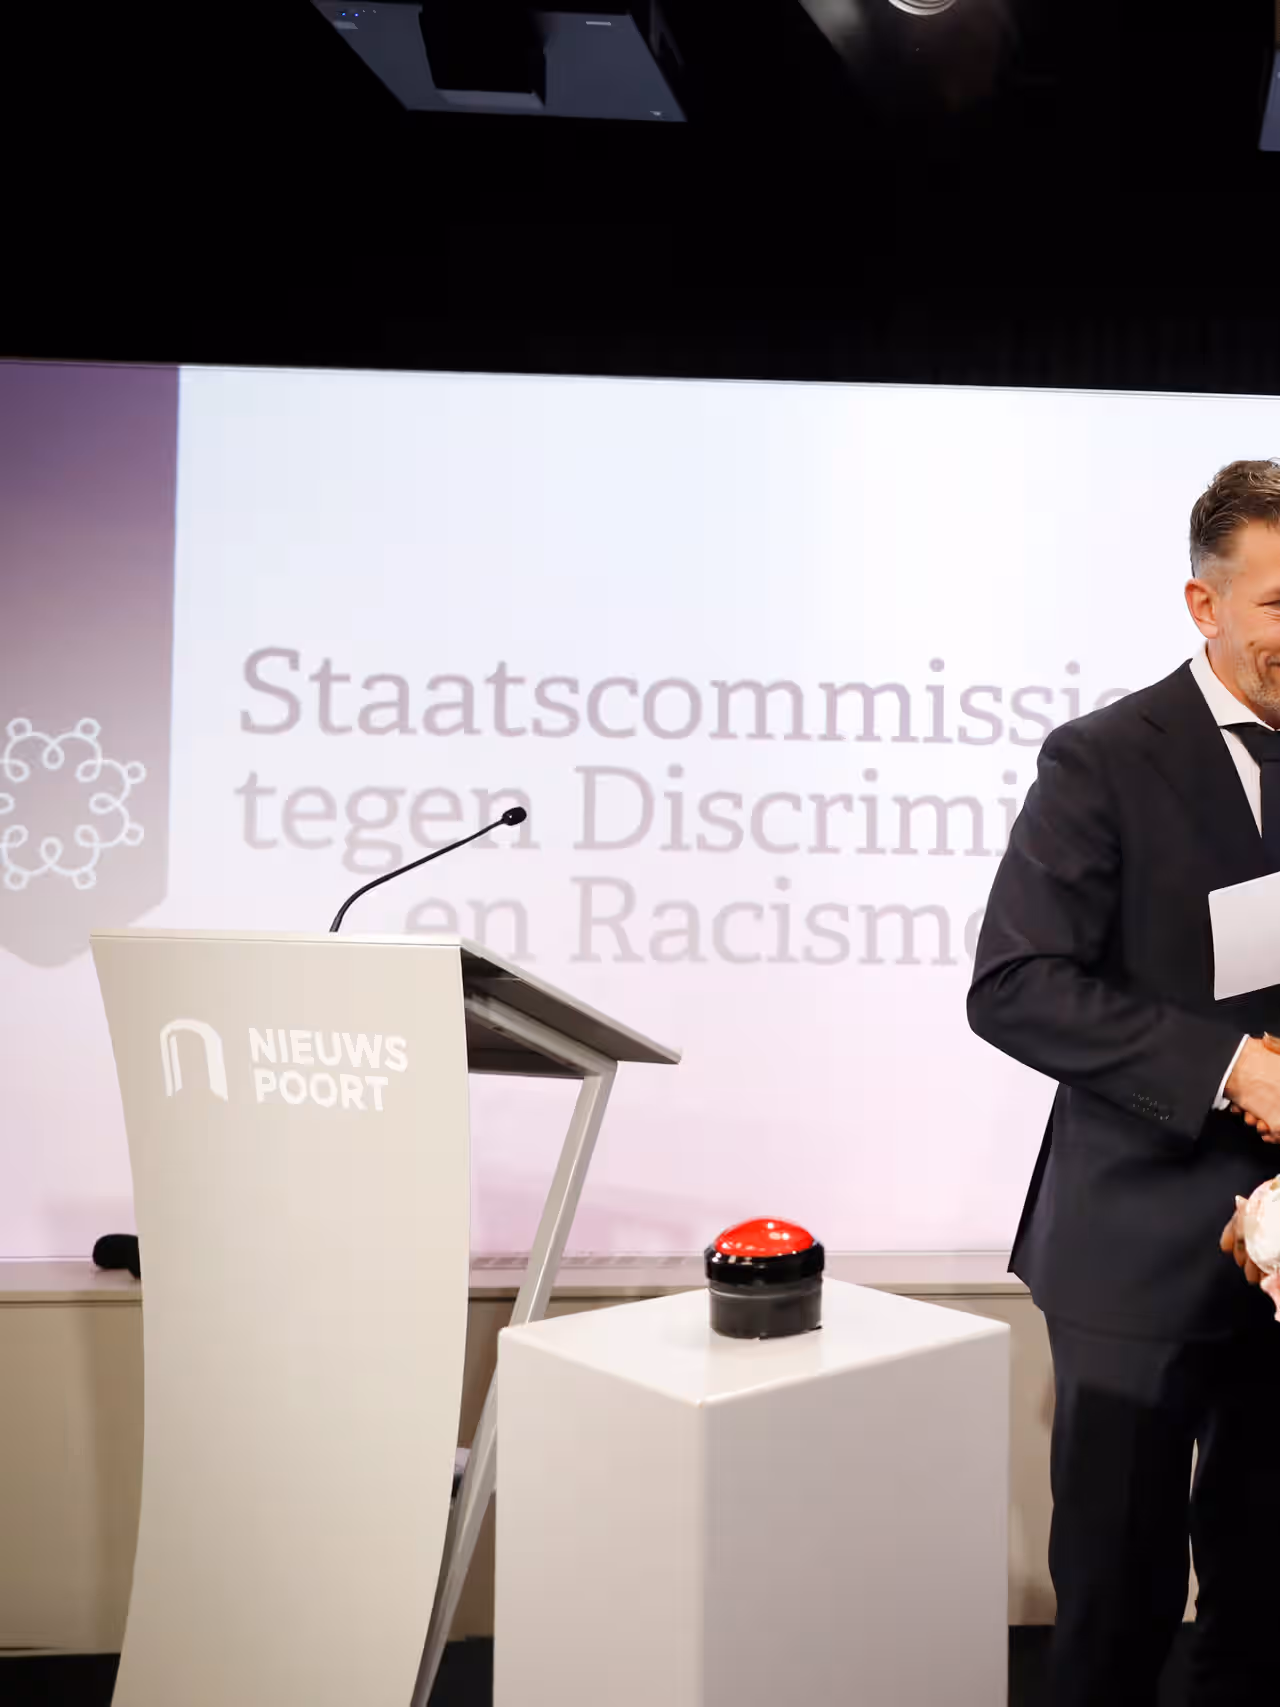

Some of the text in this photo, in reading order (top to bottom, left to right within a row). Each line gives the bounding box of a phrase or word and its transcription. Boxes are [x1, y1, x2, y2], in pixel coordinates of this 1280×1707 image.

[240, 646, 1134, 748] Staatscommissi
[234, 770, 541, 875] tegen
[248, 1027, 409, 1073] NIEUWS
[253, 1067, 389, 1112] POORT
